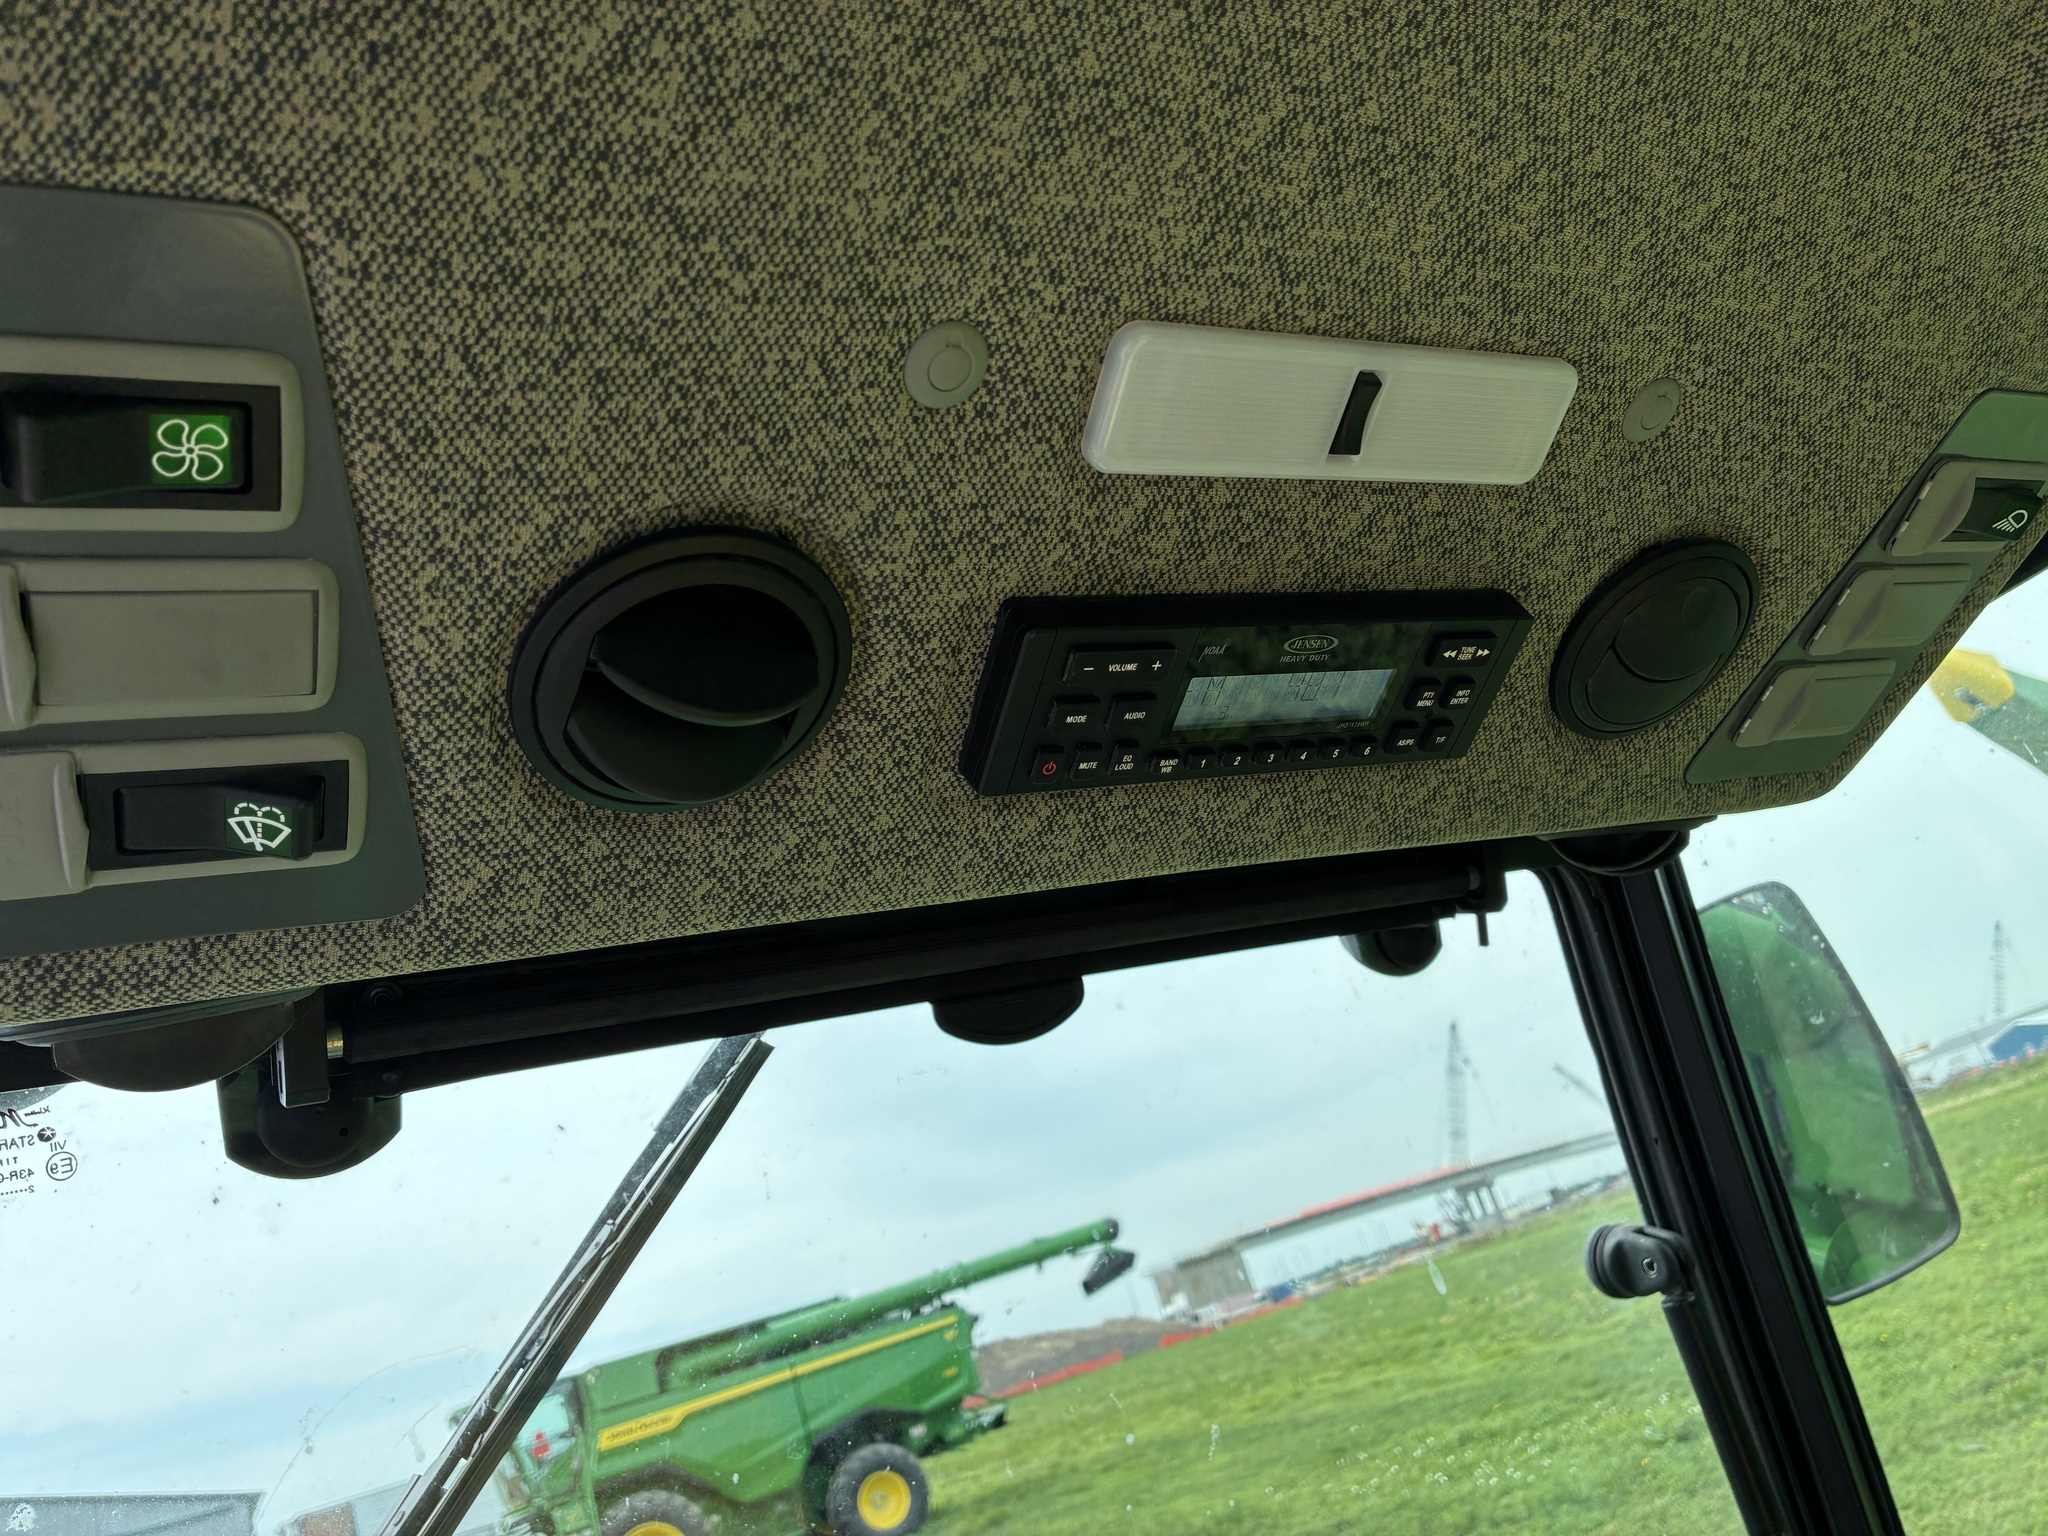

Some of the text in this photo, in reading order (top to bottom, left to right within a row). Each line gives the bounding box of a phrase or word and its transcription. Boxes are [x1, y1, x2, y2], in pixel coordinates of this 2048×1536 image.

[1290, 638, 1331, 650] JENSEN
[1198, 643, 1228, 663] NOAA
[1460, 646, 1478, 654] TUNE
[1280, 653, 1331, 663] HEAVY DUTY
[1457, 653, 1474, 661] SEEK
[1108, 662, 1139, 672] VOLUME
[1422, 691, 1436, 699] PTY
[1455, 689, 1471, 697] INFO
[1416, 699, 1435, 707] MENU
[1449, 697, 1470, 705] ENTER
[1065, 715, 1088, 724] MODE
[1123, 711, 1146, 720] AUDIO
[1332, 749, 1340, 758] 5
[1363, 746, 1372, 756] 6
[1122, 754, 1133, 762] EQ
[1267, 753, 1275, 763] 3
[1299, 751, 1308, 761] 4
[1078, 761, 1099, 770] MUTE
[1159, 758, 1179, 767] BAND
[1200, 758, 1207, 768] 1
[1233, 756, 1242, 766] 2
[1114, 763, 1134, 771] LOUD
[1160, 766, 1173, 774] WB
